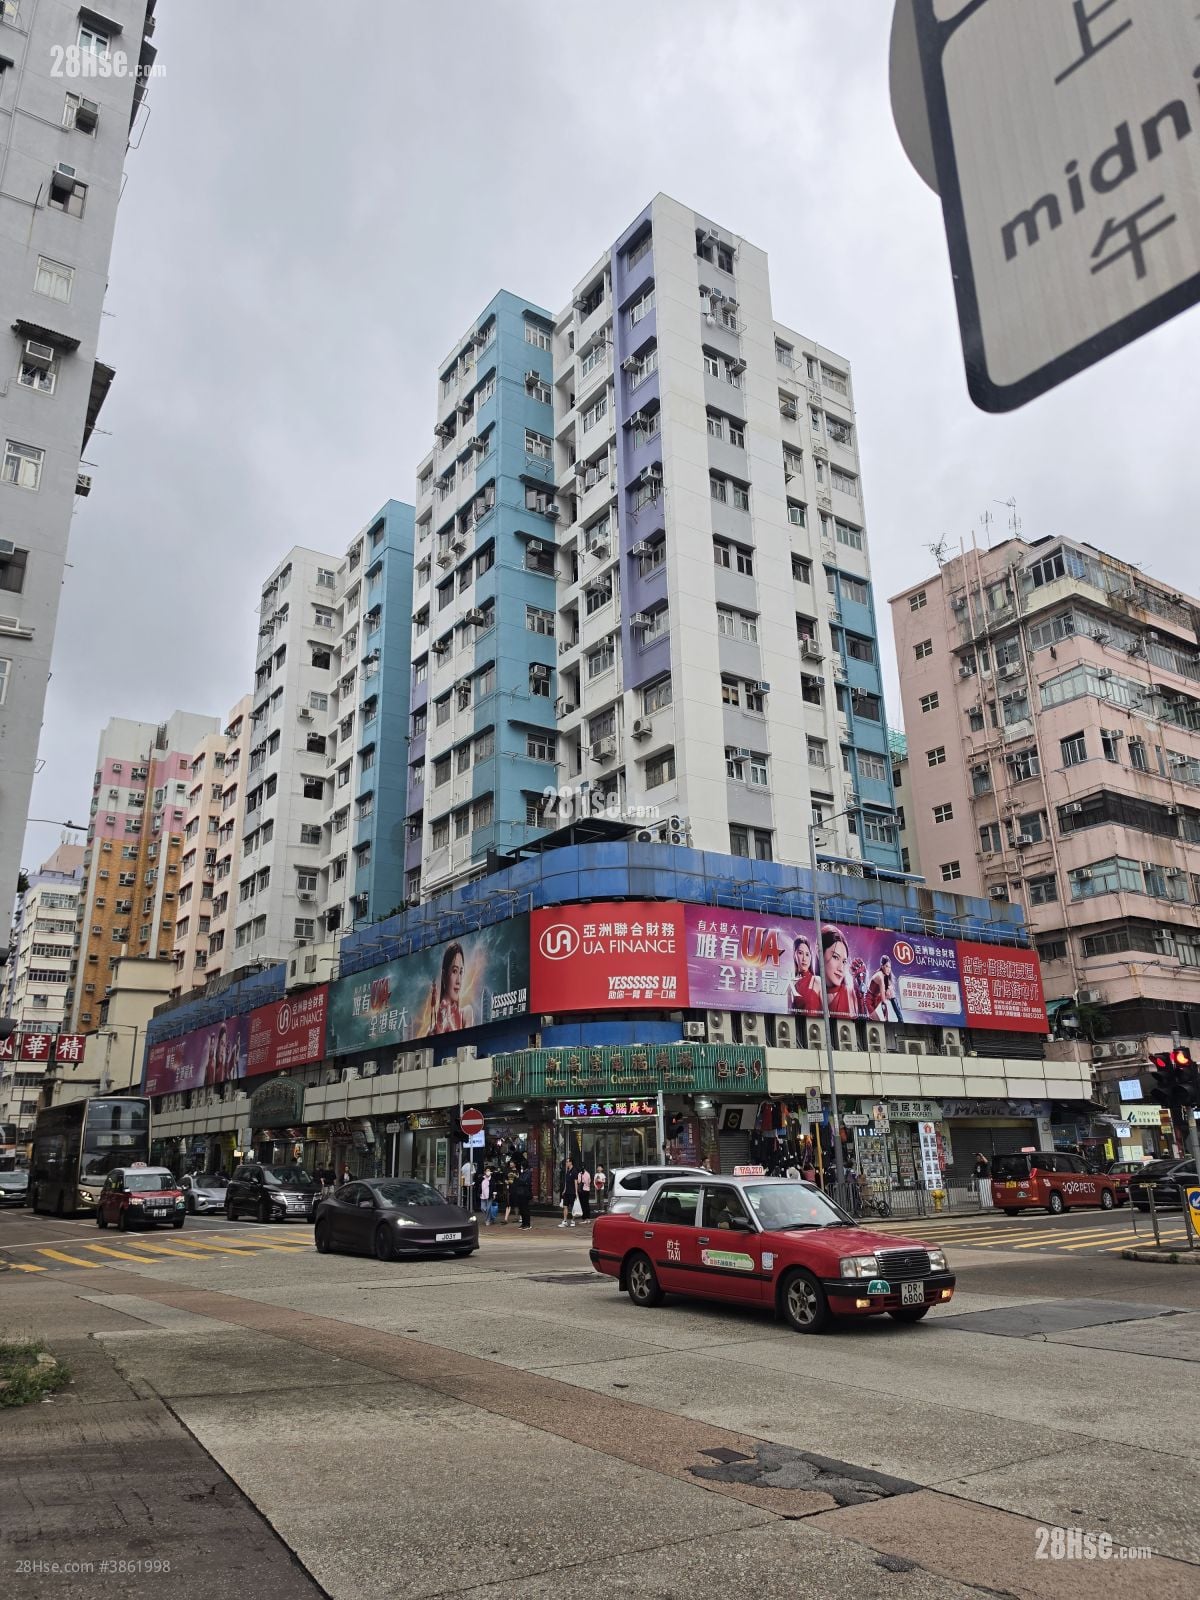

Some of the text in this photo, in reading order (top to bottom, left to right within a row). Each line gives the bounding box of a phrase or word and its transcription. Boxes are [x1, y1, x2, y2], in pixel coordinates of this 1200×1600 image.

[1001, 65, 1200, 263] midn
[1090, 194, 1177, 281] 午
[583, 922, 675, 938] 亞洲聯合財務
[583, 939, 676, 954] UA FINANCE
[916, 956, 956, 969] UA FINANCE
[662, 976, 677, 990] UA
[563, 1102, 653, 1116] 新高登電腦廣場
[740, 1166, 762, 1174] TAXI
[667, 1240, 680, 1249] 的士
[667, 1249, 680, 1260] TAXI
[907, 1284, 918, 1293] DR
